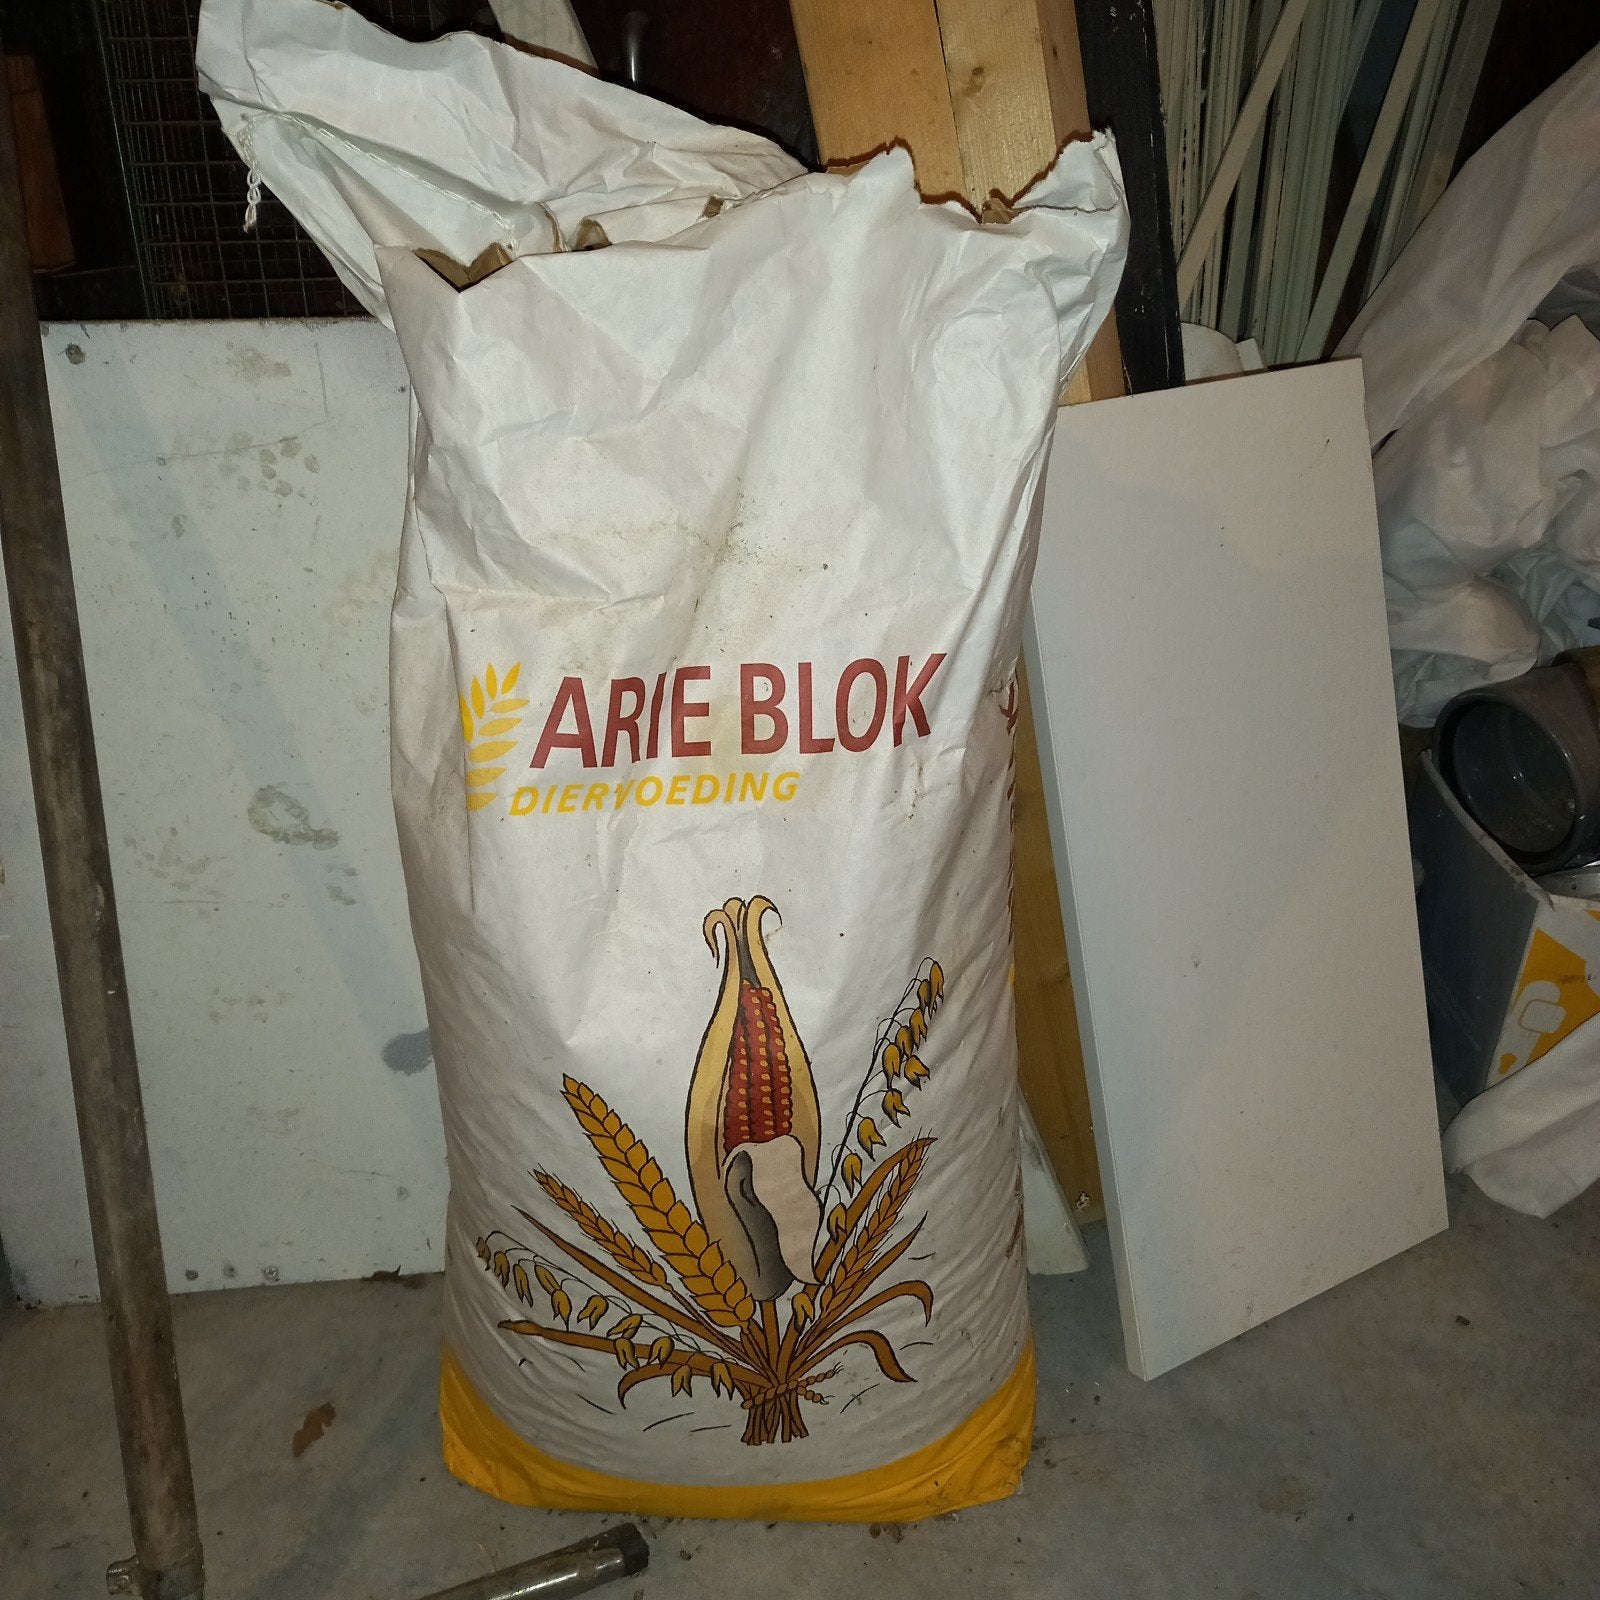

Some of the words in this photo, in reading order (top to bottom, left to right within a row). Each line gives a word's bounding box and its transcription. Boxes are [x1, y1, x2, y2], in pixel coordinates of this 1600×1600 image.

[530, 665, 711, 768] ARIE
[740, 653, 946, 755] BLOK
[509, 771, 801, 816] DIERVOEDING
